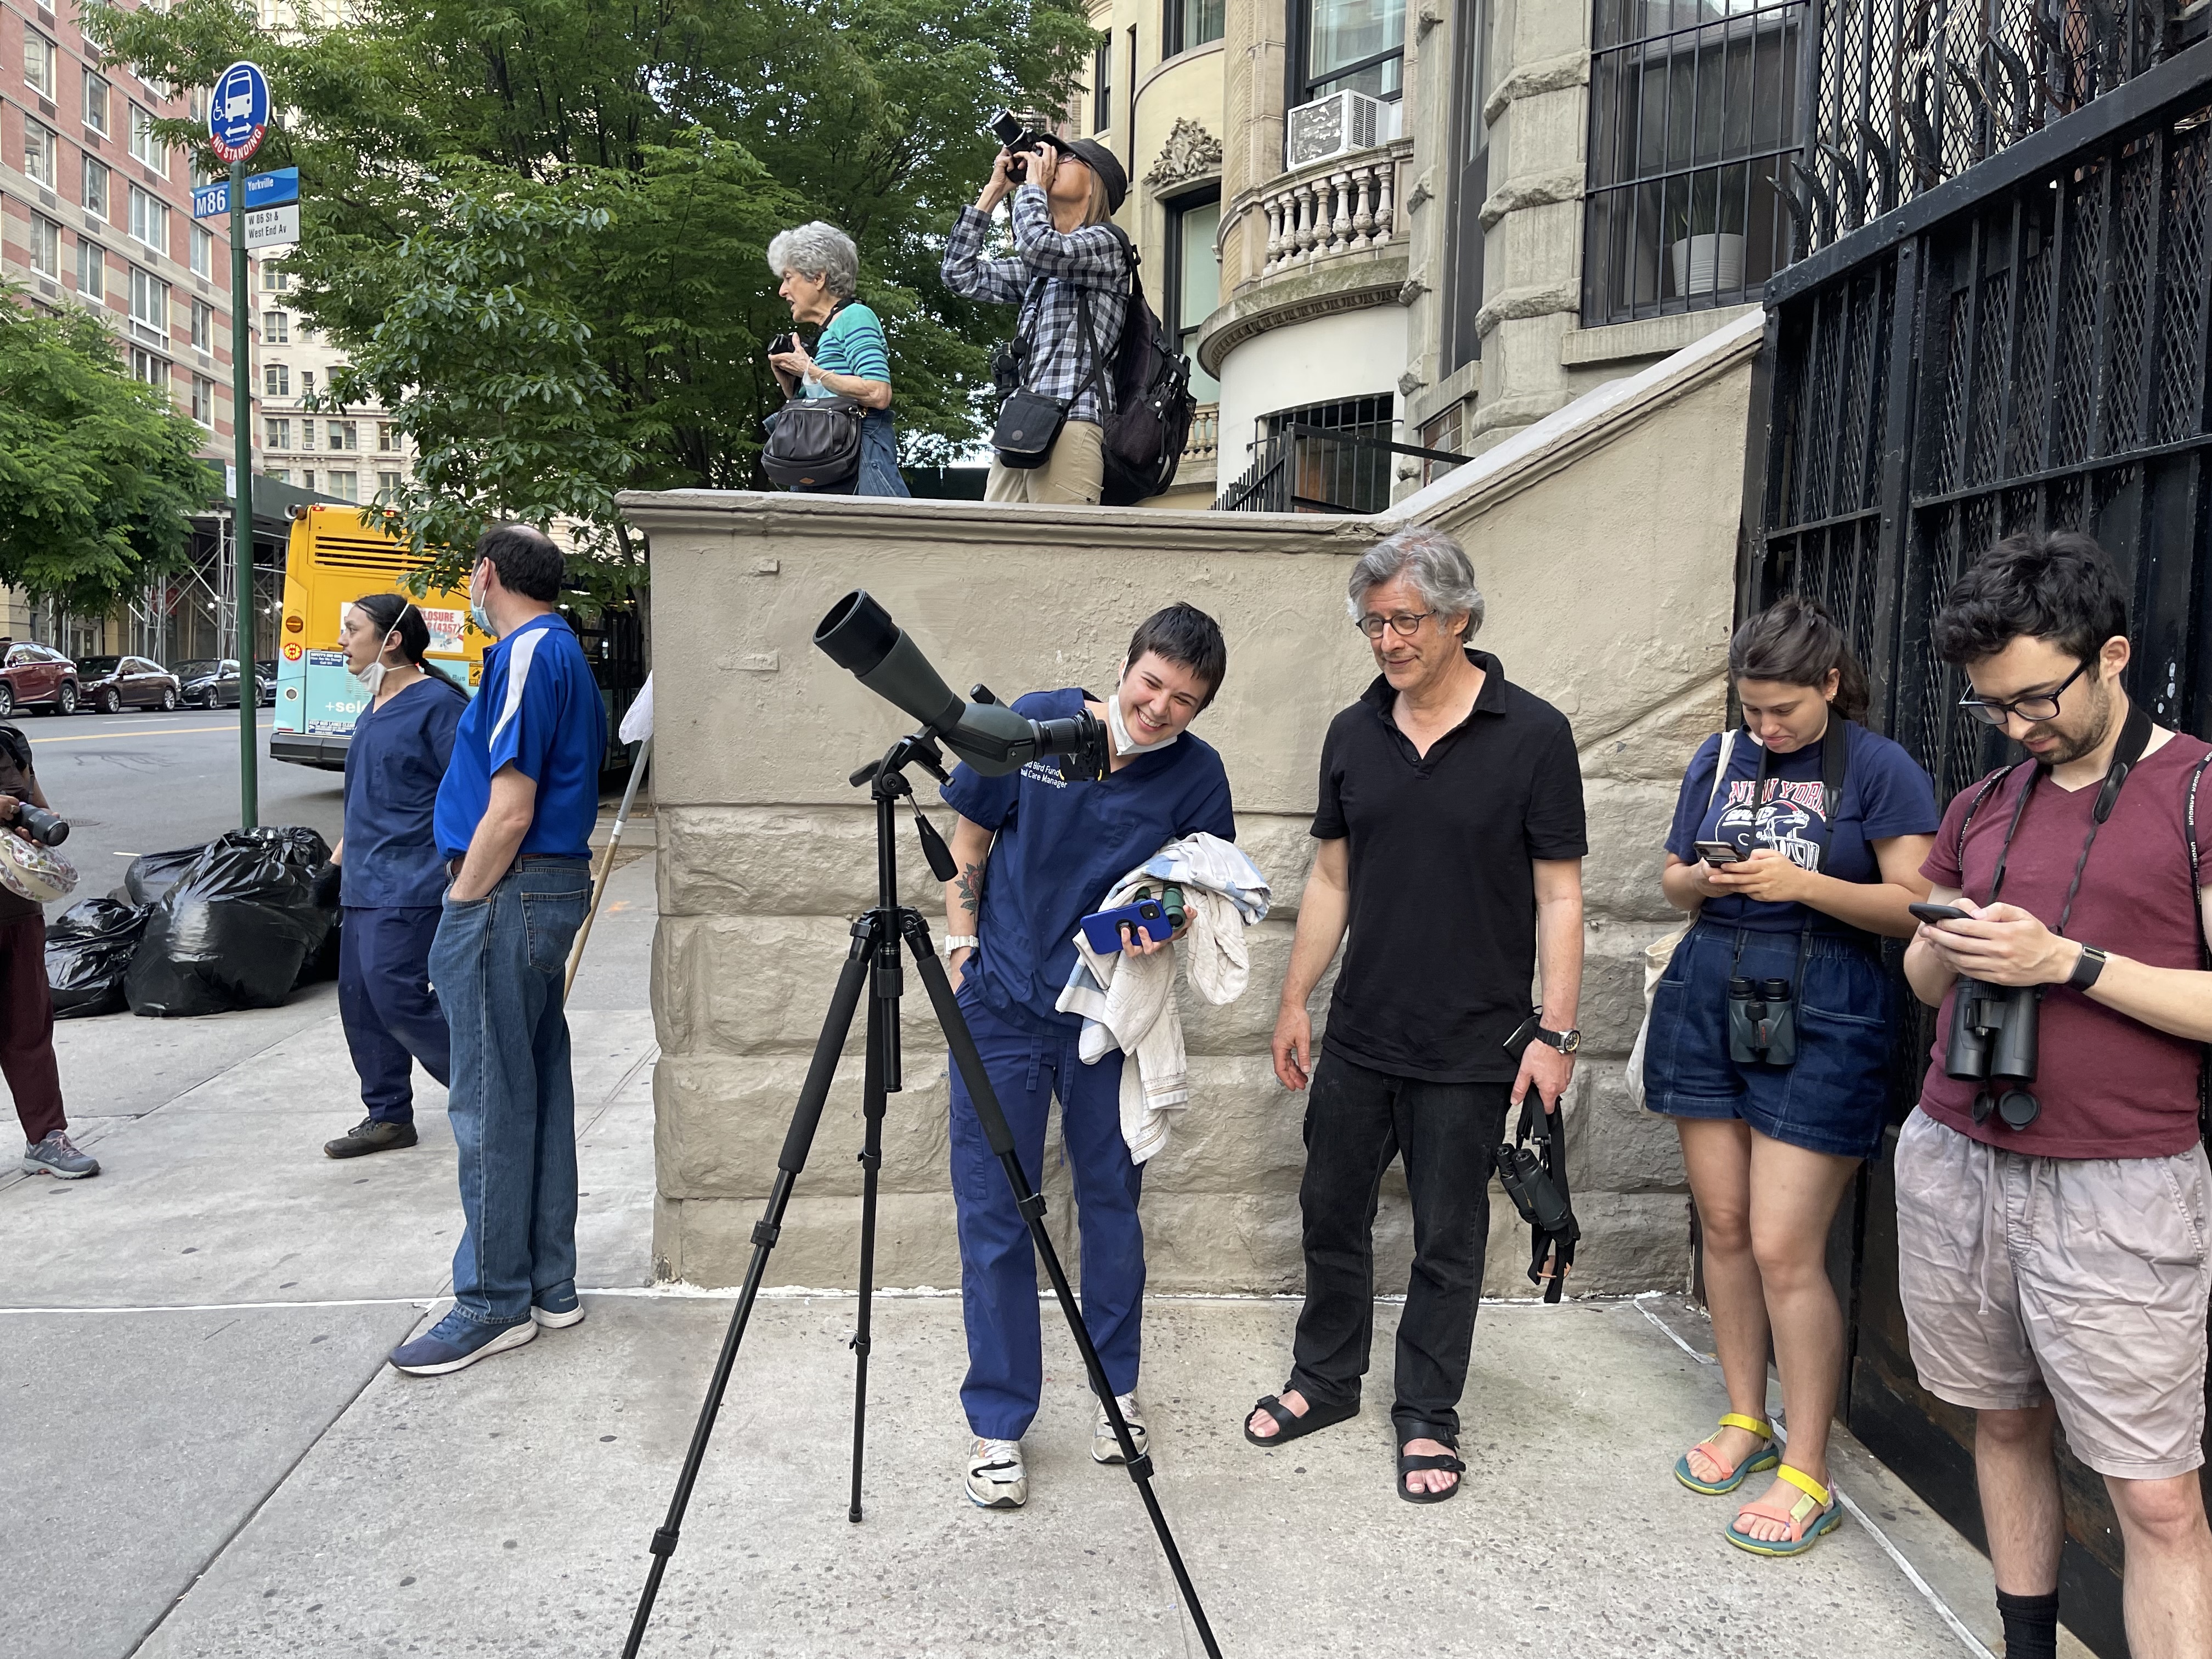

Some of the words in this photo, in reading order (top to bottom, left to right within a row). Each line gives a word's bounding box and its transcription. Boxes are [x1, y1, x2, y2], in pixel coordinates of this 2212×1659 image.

[213, 136, 224, 153] NO
[223, 129, 262, 160] STANDING
[247, 177, 274, 191] Yorkville
[196, 189, 226, 216] M86
[249, 215, 255, 225] W
[256, 213, 264, 224] 86
[266, 212, 272, 222] St
[274, 211, 279, 221] &
[249, 228, 264, 239] West
[266, 225, 276, 236] End
[279, 224, 286, 234] Av
[434, 622, 461, 633] (4357)
[1032, 761, 1046, 772] Bird
[1045, 765, 1060, 777] Fund
[1028, 770, 1041, 781] Care
[1041, 774, 1068, 788] Manager
[2191, 770, 2202, 792] UNDER
[1722, 778, 1780, 811] NEW
